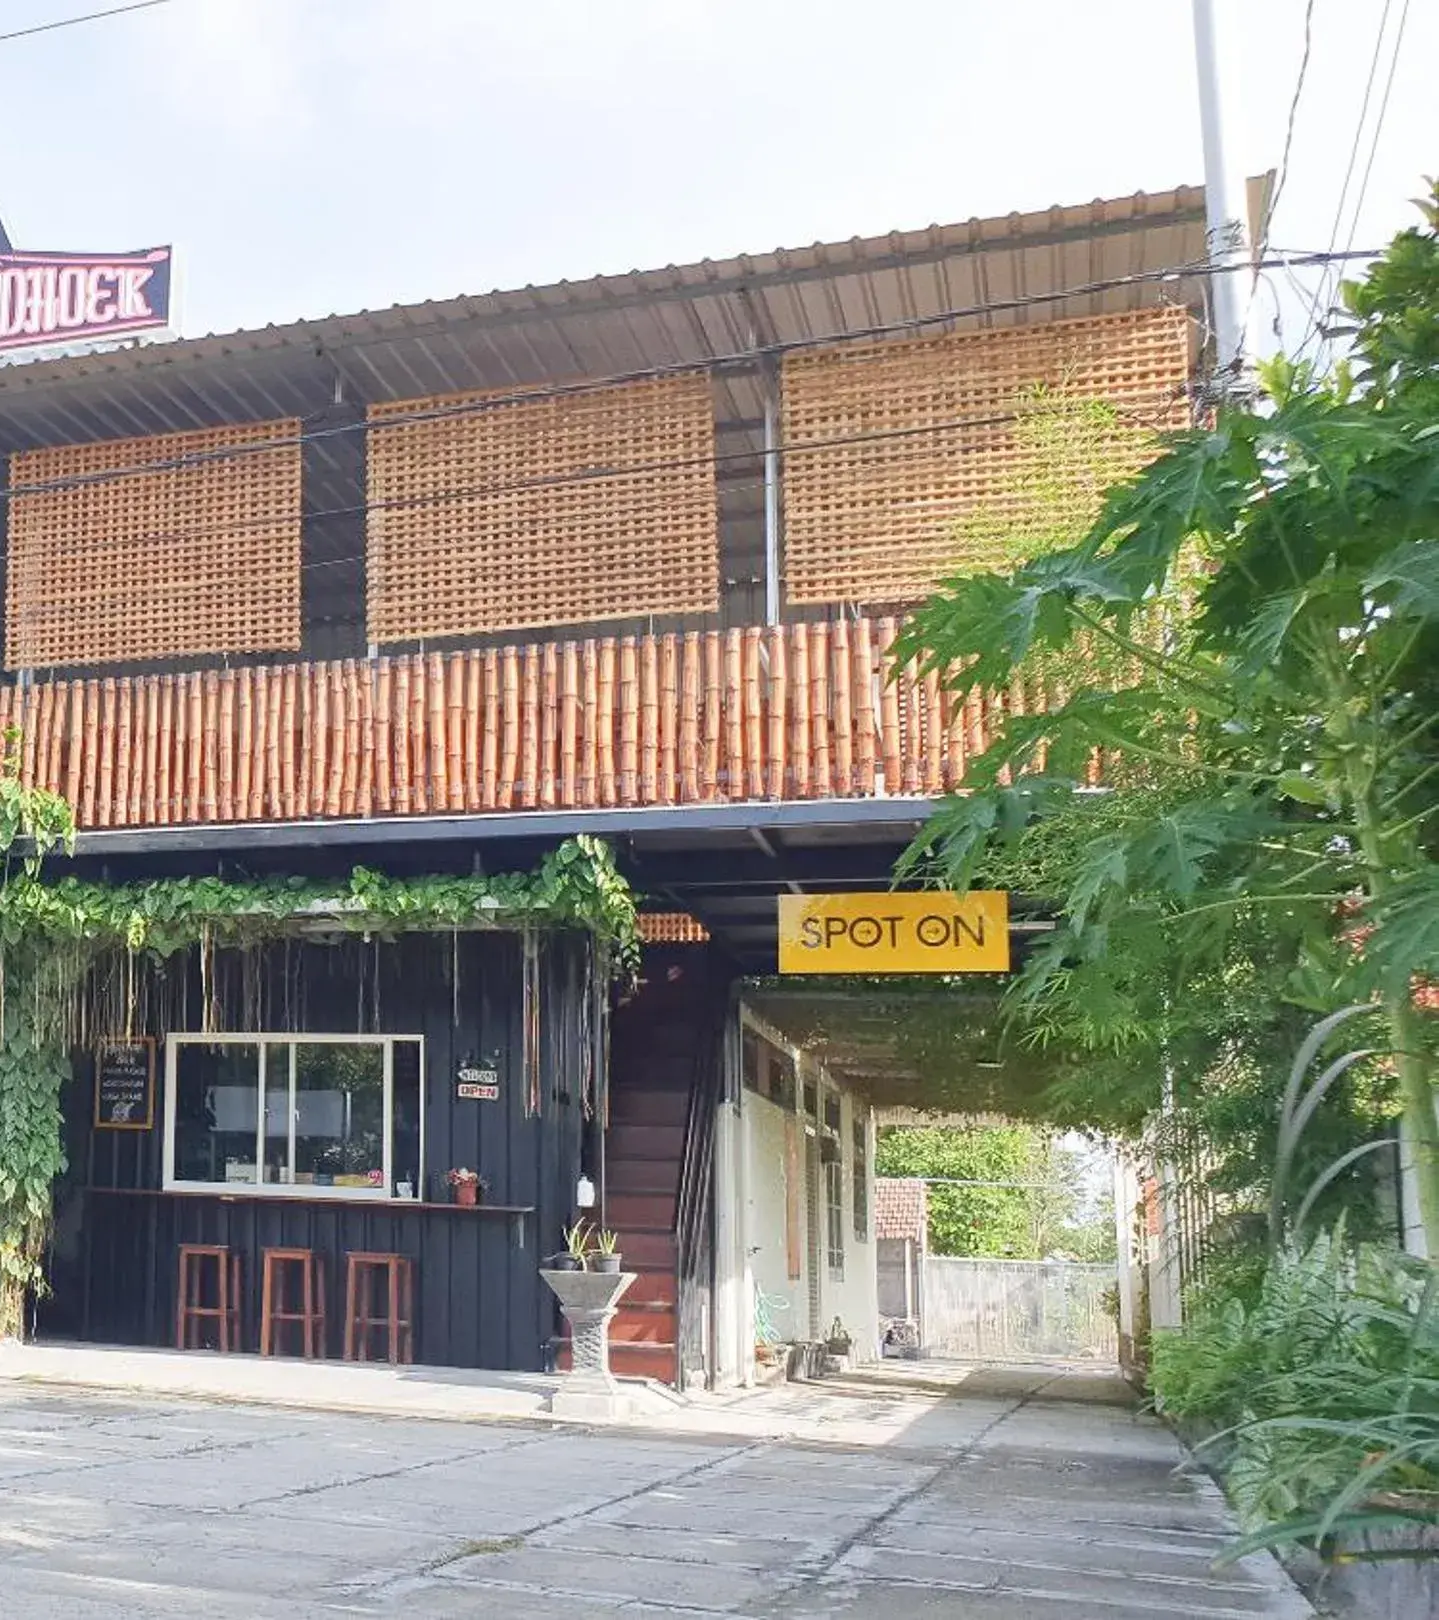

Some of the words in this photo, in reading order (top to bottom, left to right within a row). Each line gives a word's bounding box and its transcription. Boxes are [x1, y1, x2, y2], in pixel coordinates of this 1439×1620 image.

[801, 916, 904, 949] SPOT
[917, 915, 984, 947] ON
[461, 1086, 496, 1097] OPEN
